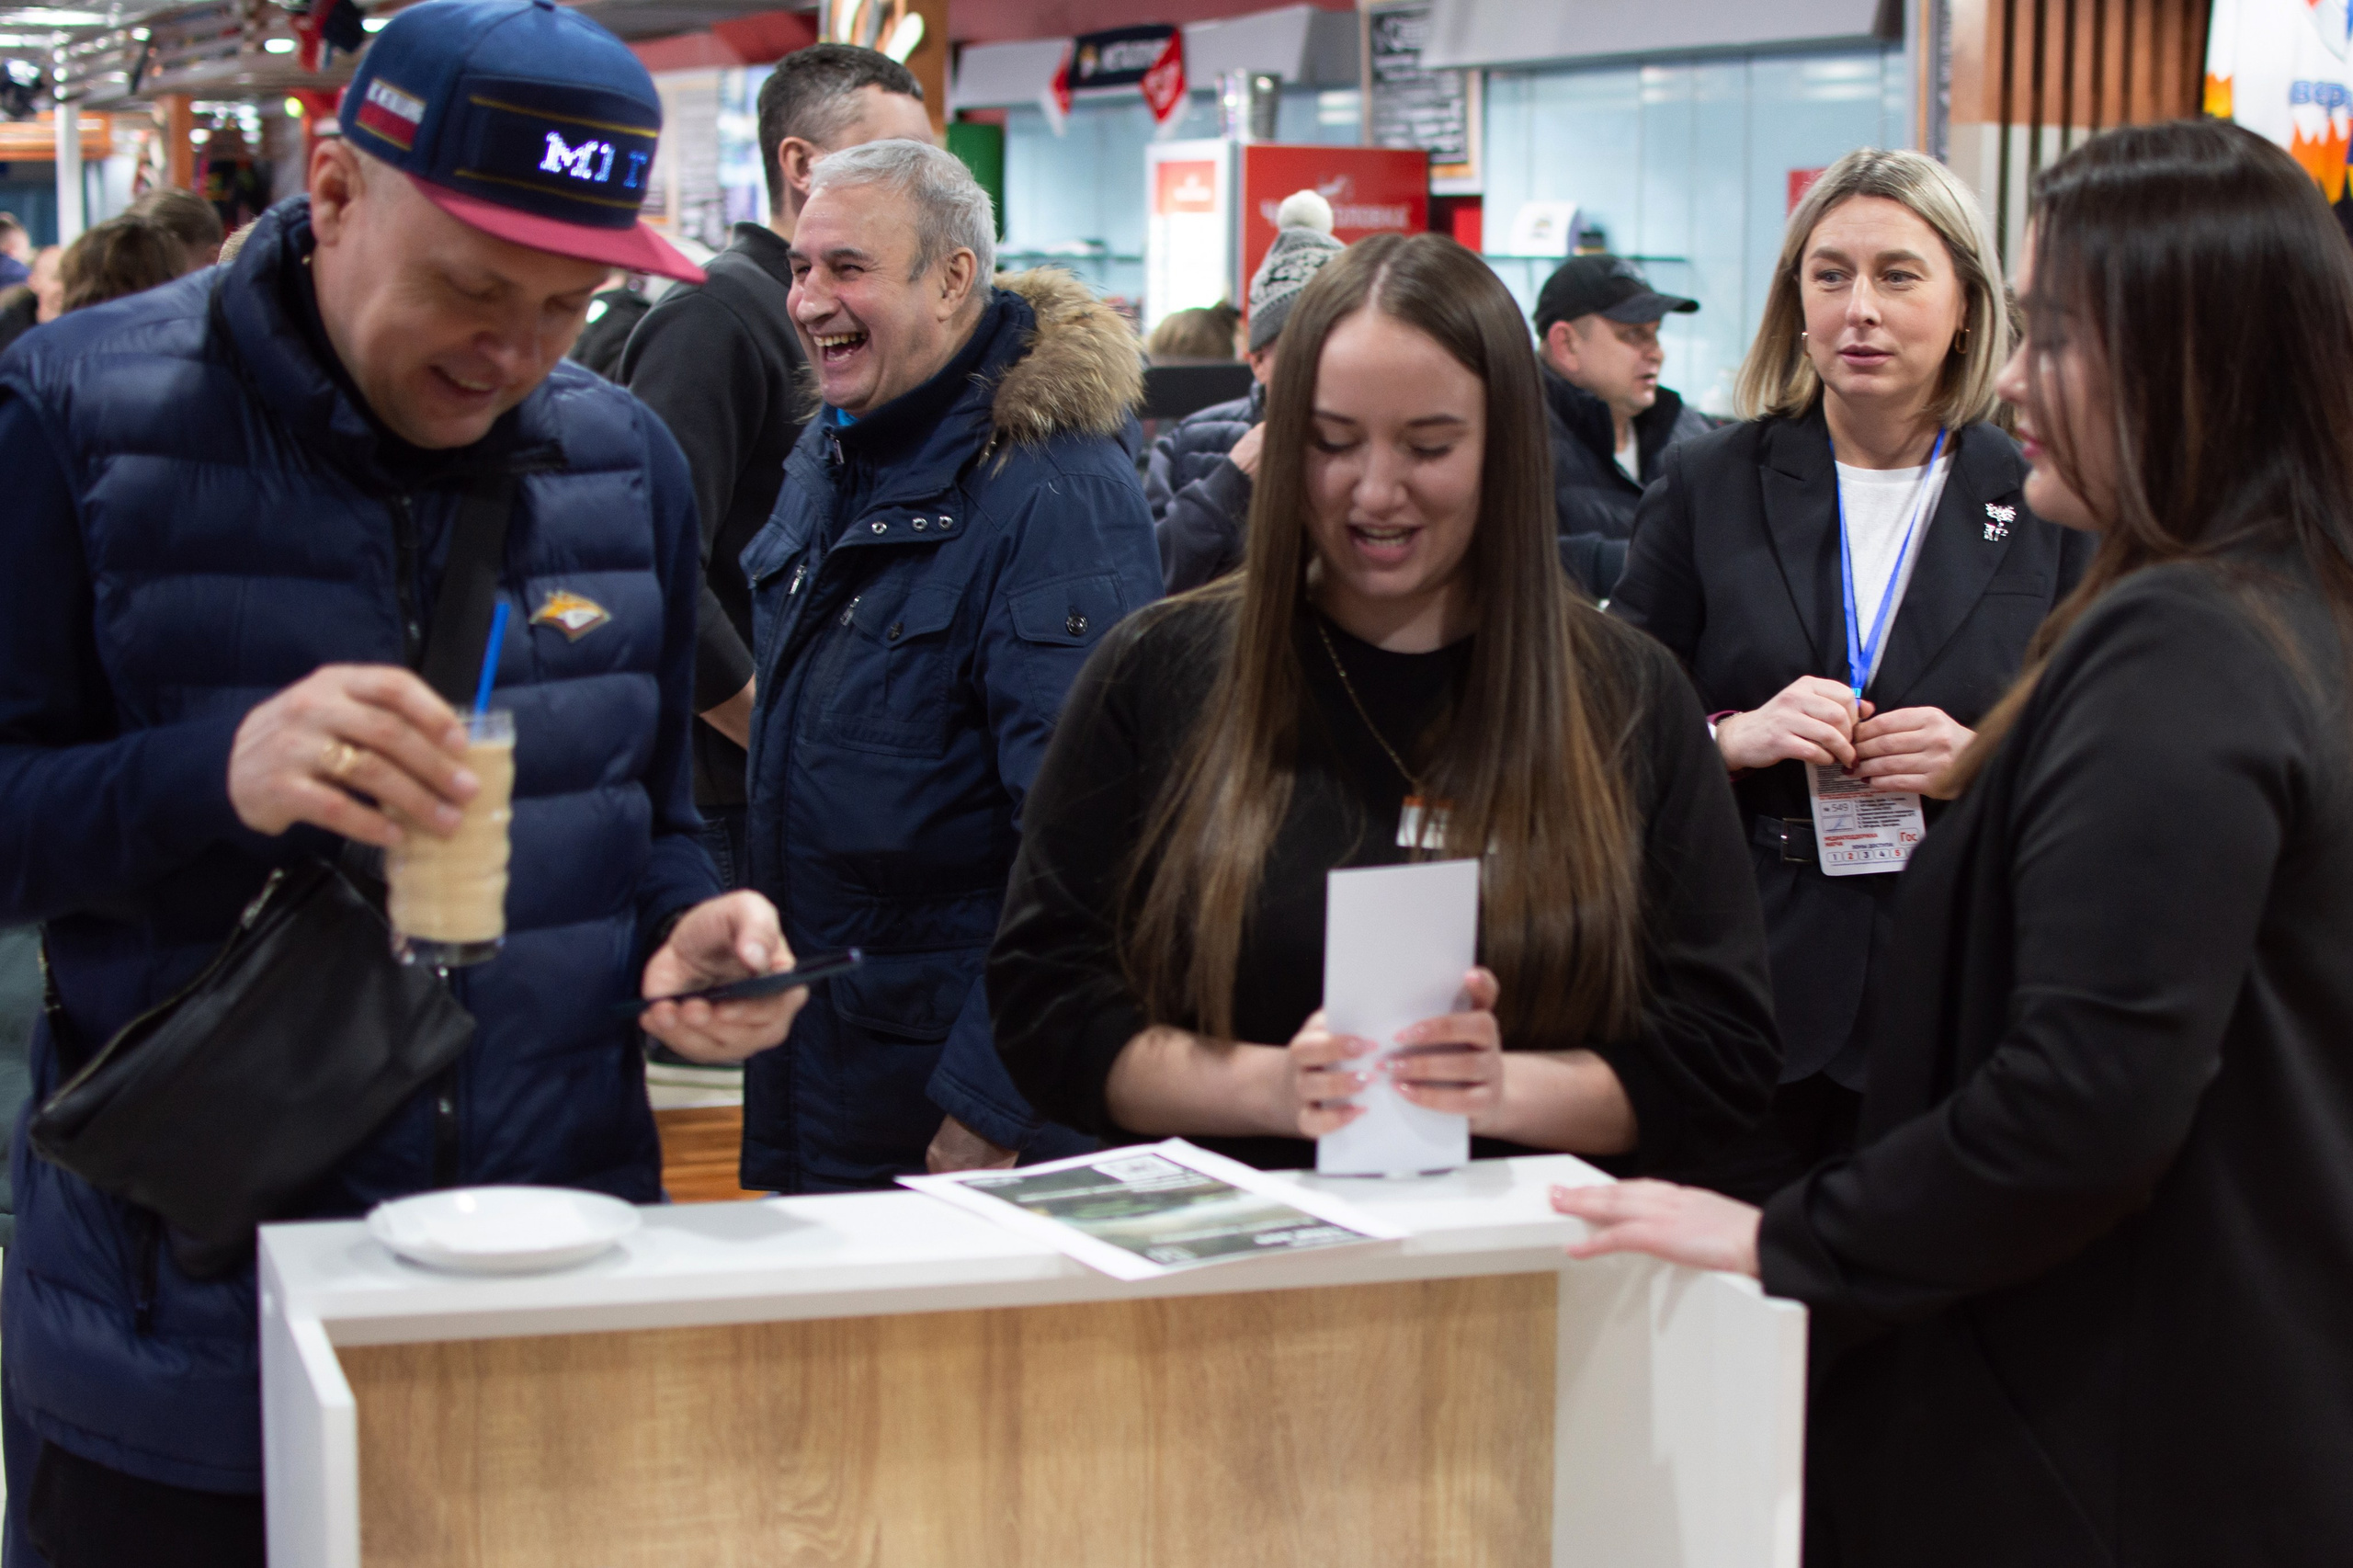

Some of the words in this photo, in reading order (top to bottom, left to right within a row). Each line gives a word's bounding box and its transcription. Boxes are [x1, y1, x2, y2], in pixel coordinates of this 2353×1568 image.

[1831, 802, 1849, 812] 549
[1899, 831, 1918, 842] Гос
[1833, 853, 1838, 861] 1
[1847, 852, 1854, 860] 2
[1863, 851, 1870, 859] 3
[1894, 848, 1901, 857] 5
